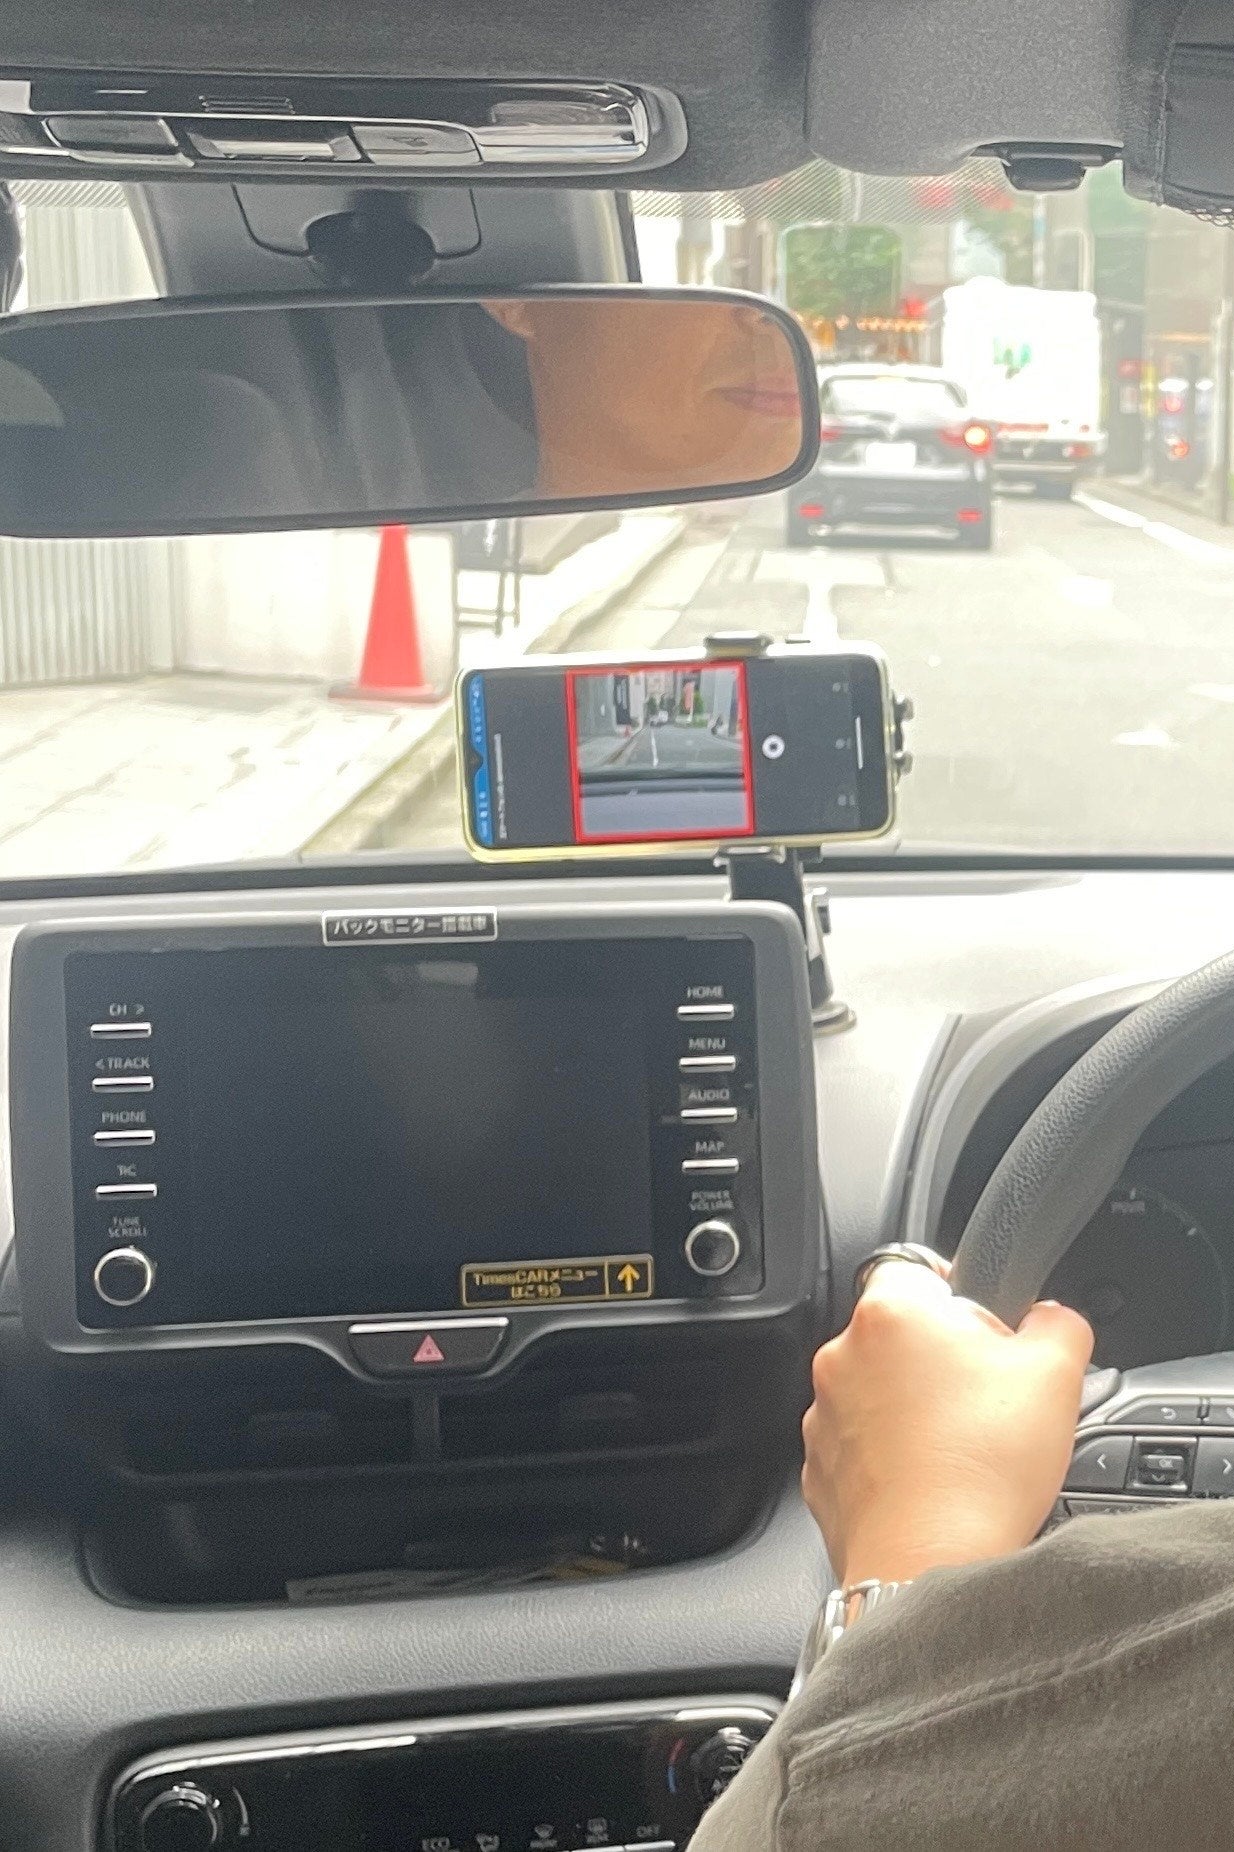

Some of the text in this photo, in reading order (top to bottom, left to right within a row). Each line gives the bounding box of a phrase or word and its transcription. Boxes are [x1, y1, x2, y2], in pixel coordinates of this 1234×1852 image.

[686, 985, 724, 998] HOME
[109, 1003, 128, 1016] CH
[688, 1037, 726, 1050] MENU
[106, 1057, 150, 1070] TRACK
[688, 1088, 730, 1101] AUDIO
[101, 1110, 146, 1124] PHONE
[695, 1140, 725, 1153] MAP
